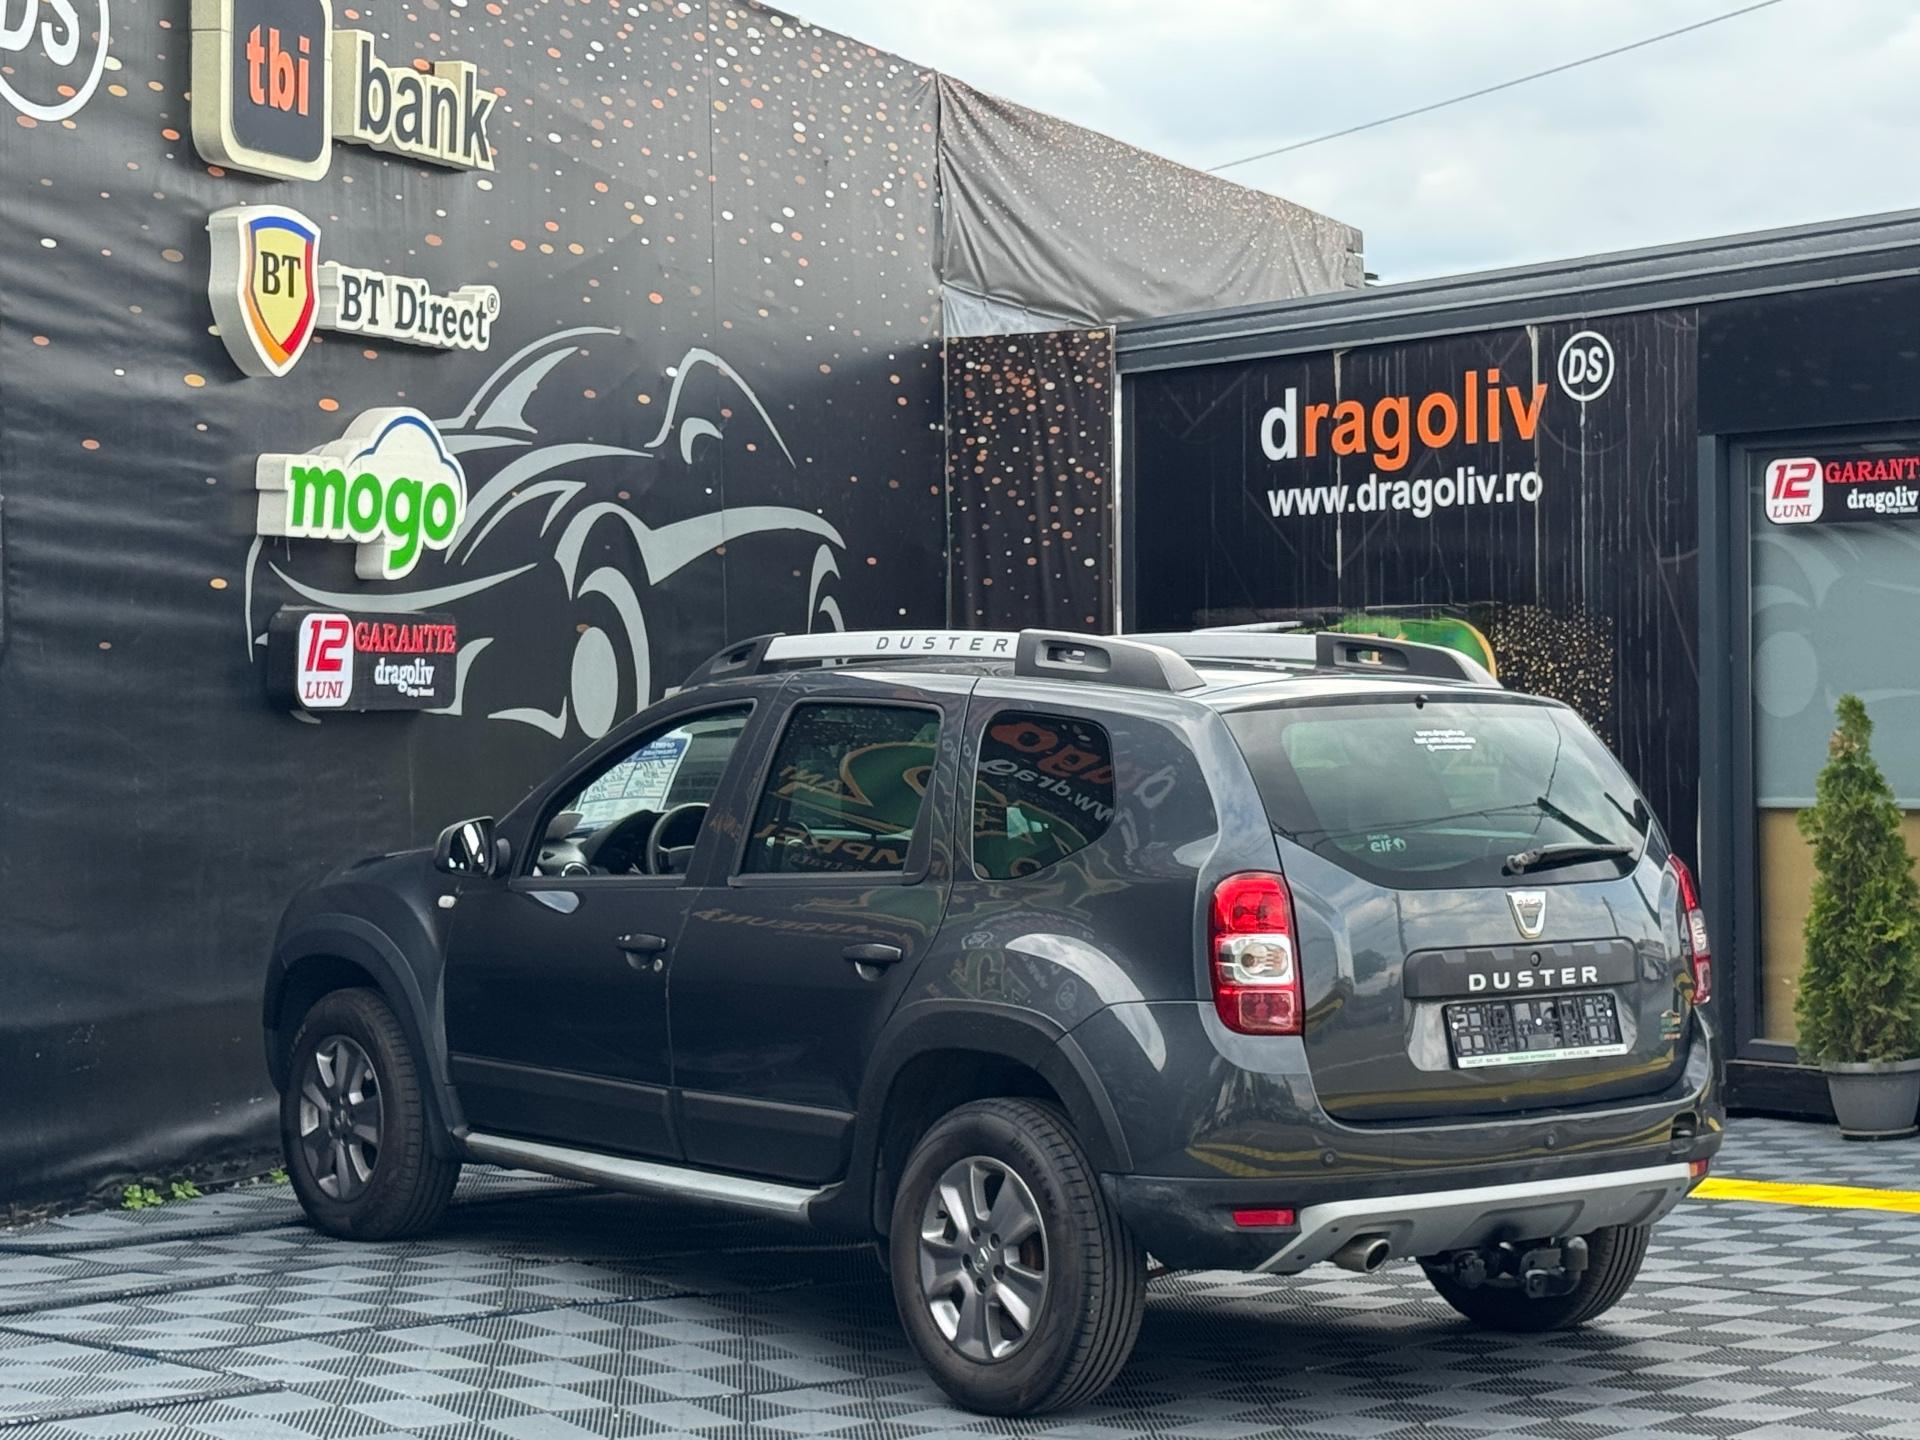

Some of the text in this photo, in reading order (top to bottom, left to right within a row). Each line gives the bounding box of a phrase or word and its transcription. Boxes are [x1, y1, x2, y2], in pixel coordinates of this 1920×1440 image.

[246, 23, 494, 163] tbi bank
[260, 251, 301, 299] BT
[341, 274, 385, 325] BT
[1567, 346, 1604, 385] DS
[1260, 367, 1549, 472] dragoliv
[1772, 462, 1817, 500] 12
[1824, 456, 1920, 484] GARANT
[1266, 466, 1544, 519] www.dragoliv.ro
[1846, 485, 1919, 514] dragoliv
[290, 465, 457, 571] mogo
[1772, 504, 1812, 519] LUNI
[304, 619, 349, 673] 12
[354, 622, 457, 654] GARANTIE
[875, 636, 1009, 653] DUSTER
[304, 680, 343, 700] LUNI
[374, 656, 436, 693] dragoliv
[1370, 838, 1393, 853] elf
[1468, 965, 1599, 992] DUSTER
